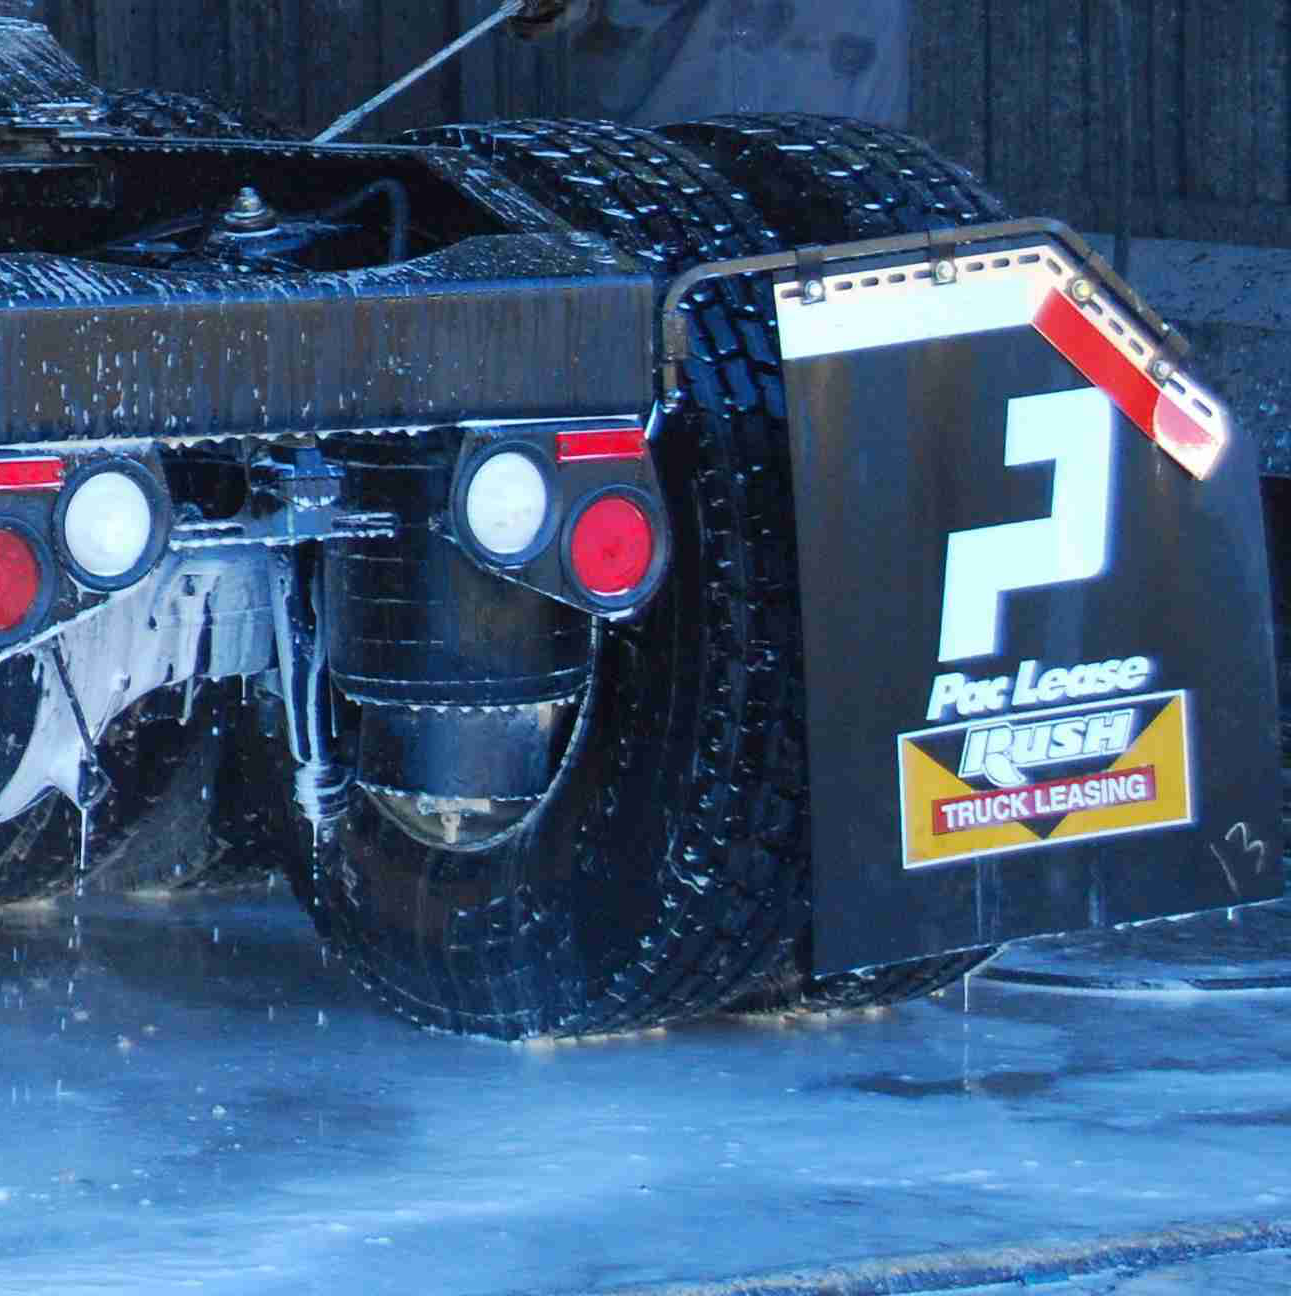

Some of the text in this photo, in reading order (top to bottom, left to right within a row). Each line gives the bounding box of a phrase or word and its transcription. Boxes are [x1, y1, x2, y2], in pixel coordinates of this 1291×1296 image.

[926, 656, 1150, 720] Pac Lease
[957, 708, 1135, 788] RUSH
[941, 774, 1148, 831] TRUCK LEASING
